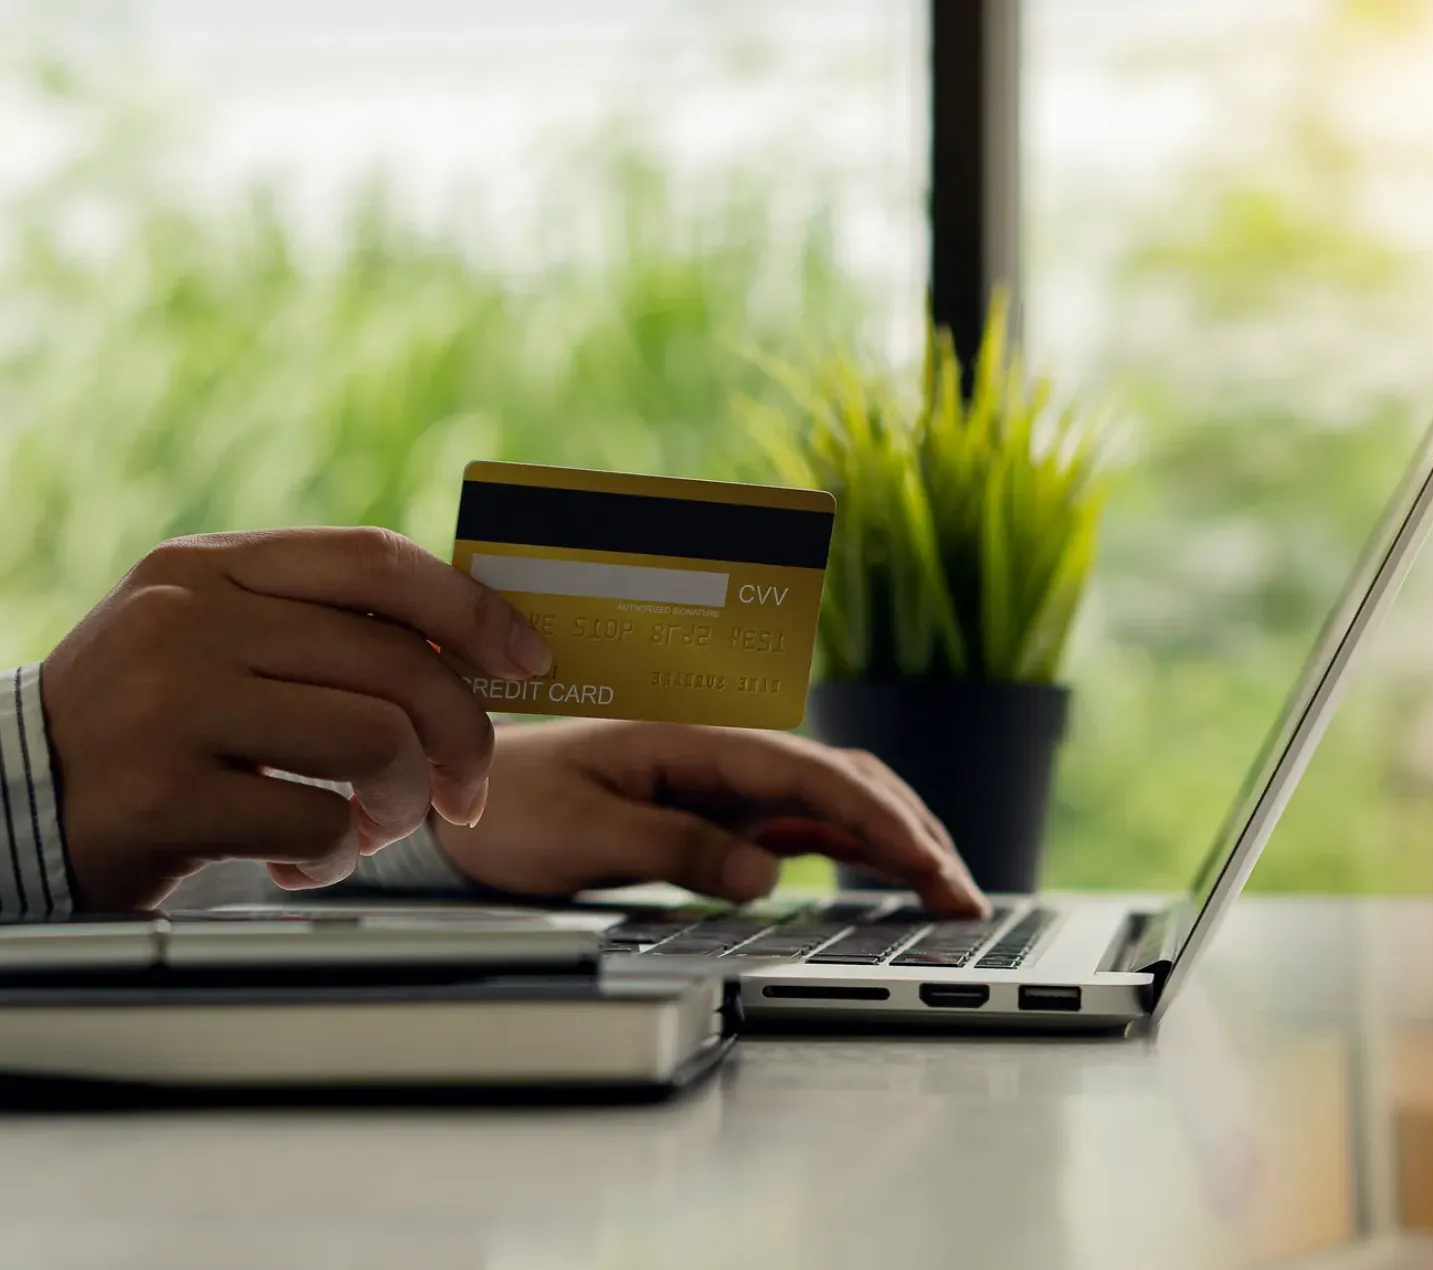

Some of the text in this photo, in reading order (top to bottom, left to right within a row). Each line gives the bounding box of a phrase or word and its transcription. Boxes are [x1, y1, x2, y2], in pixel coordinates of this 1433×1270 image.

[738, 584, 789, 606] CVV
[617, 603, 721, 618] AUTHORIZED SIGNATURE
[462, 677, 614, 705] REDIT CARD
